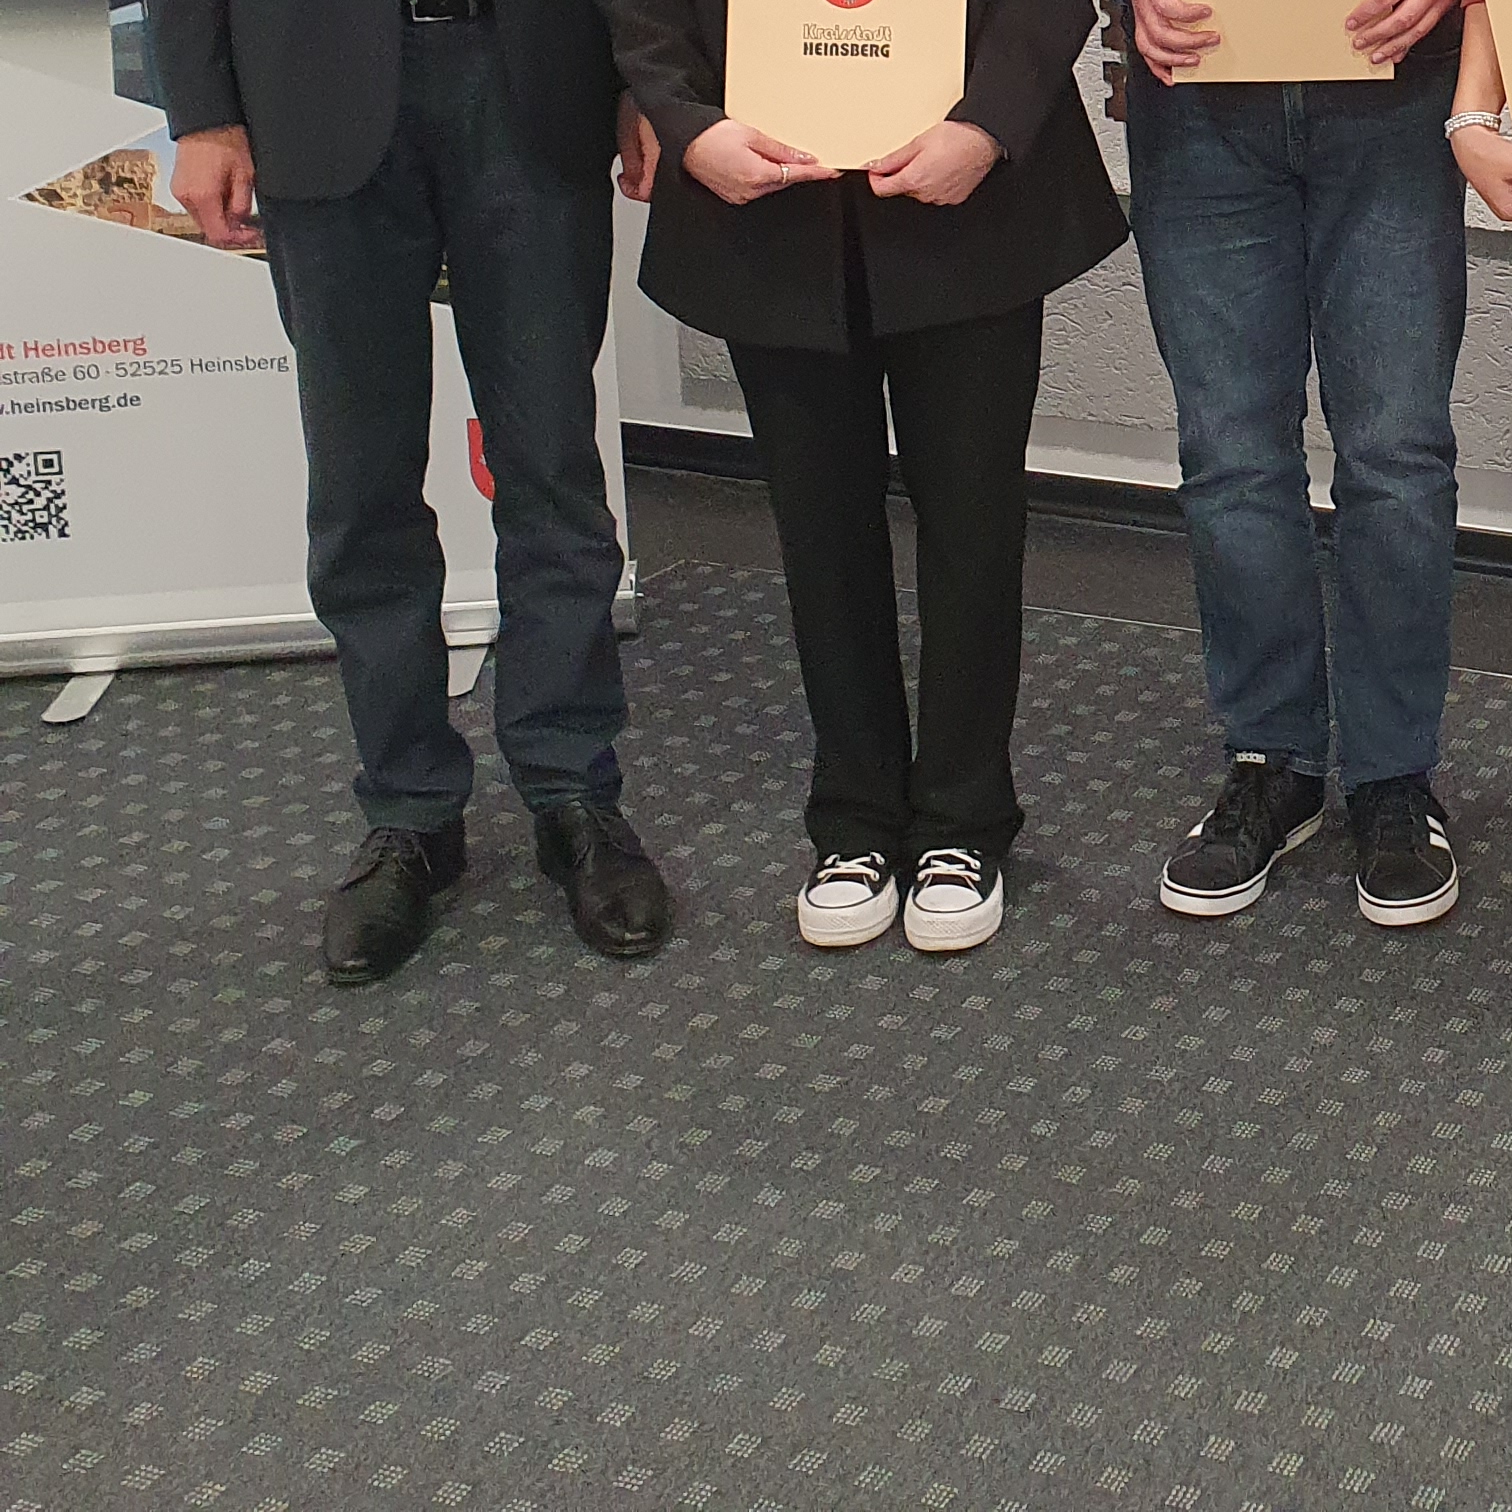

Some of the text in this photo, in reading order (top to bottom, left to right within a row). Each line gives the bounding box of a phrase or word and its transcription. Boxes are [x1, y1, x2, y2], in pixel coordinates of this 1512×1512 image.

[803, 23, 892, 41] Kreisstadt
[803, 41, 890, 58] HEINSBERG
[23, 335, 148, 357] Heinsberg
[0, 354, 290, 386] straße 60 52525 Heinsberg
